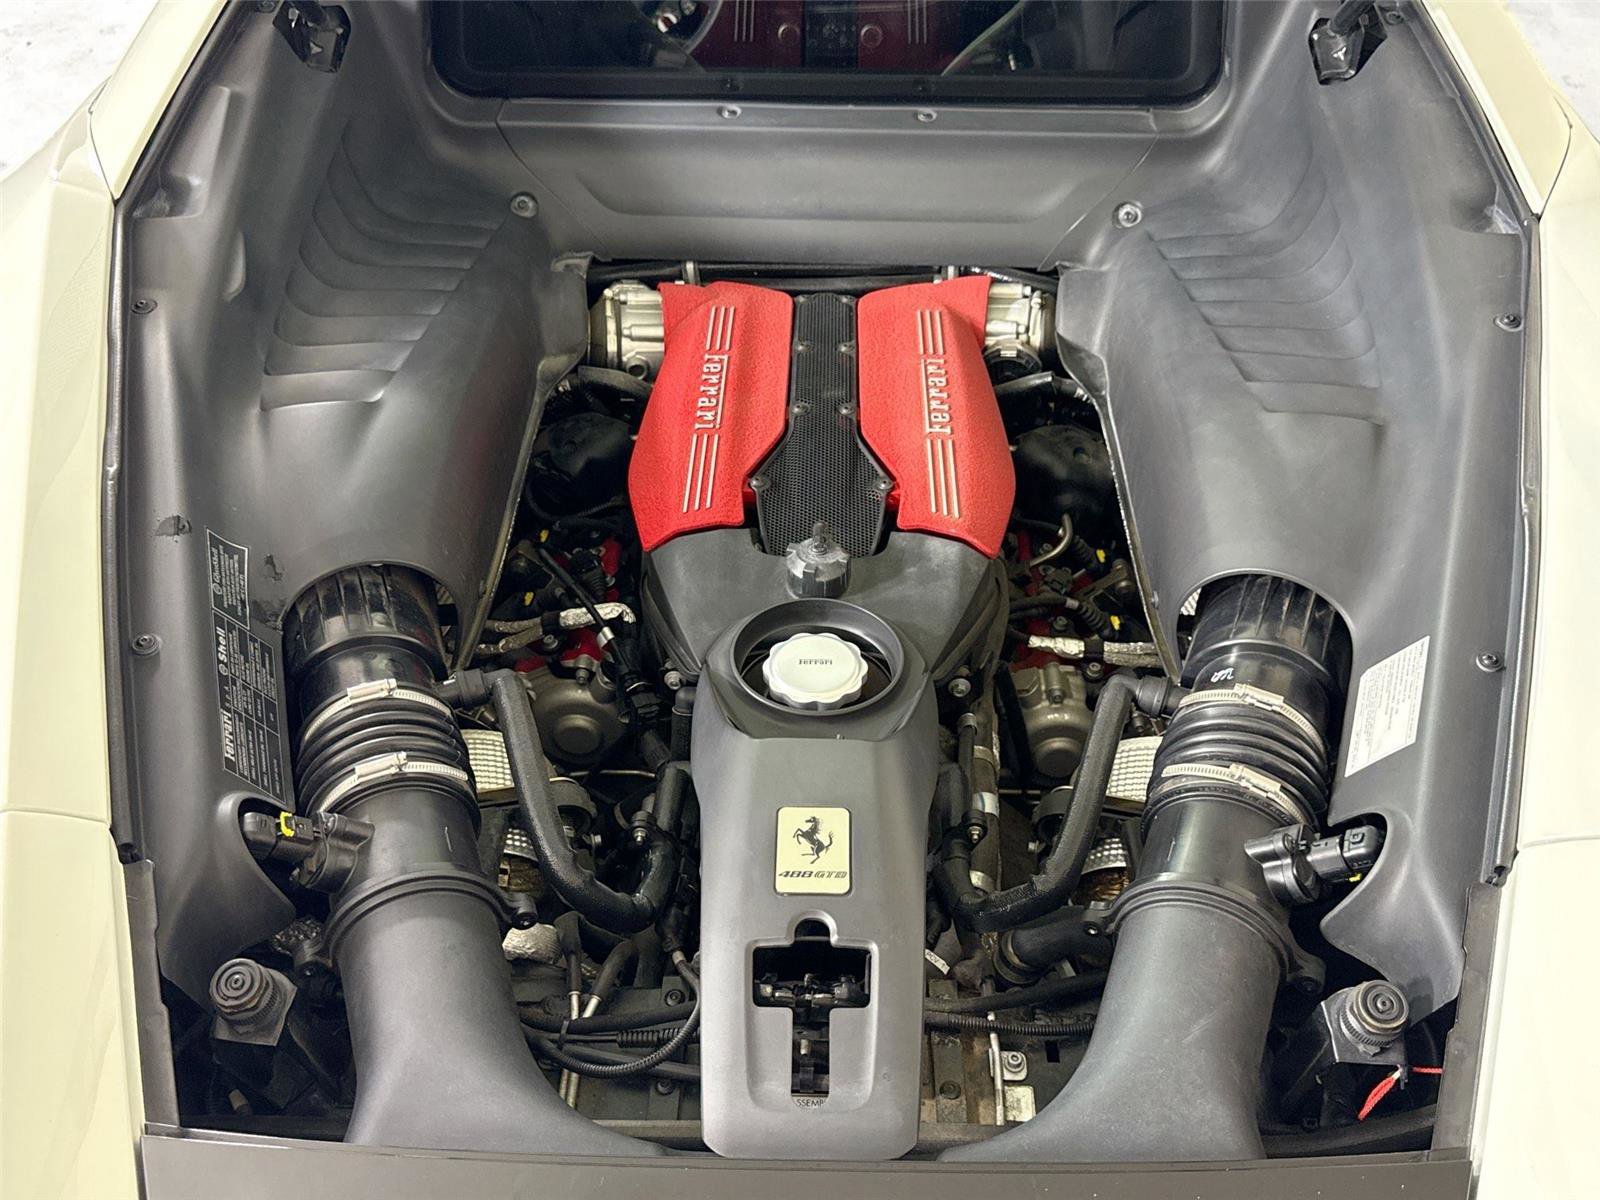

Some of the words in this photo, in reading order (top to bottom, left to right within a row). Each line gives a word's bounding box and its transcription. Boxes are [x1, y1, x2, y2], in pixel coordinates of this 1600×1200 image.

[695, 354, 728, 430] Ferrari
[921, 358, 951, 435] Ferrari
[216, 626, 227, 662] Shell
[798, 658, 833, 666] Ferrari
[220, 708, 235, 762] Ferrari
[778, 870, 814, 878] 488
